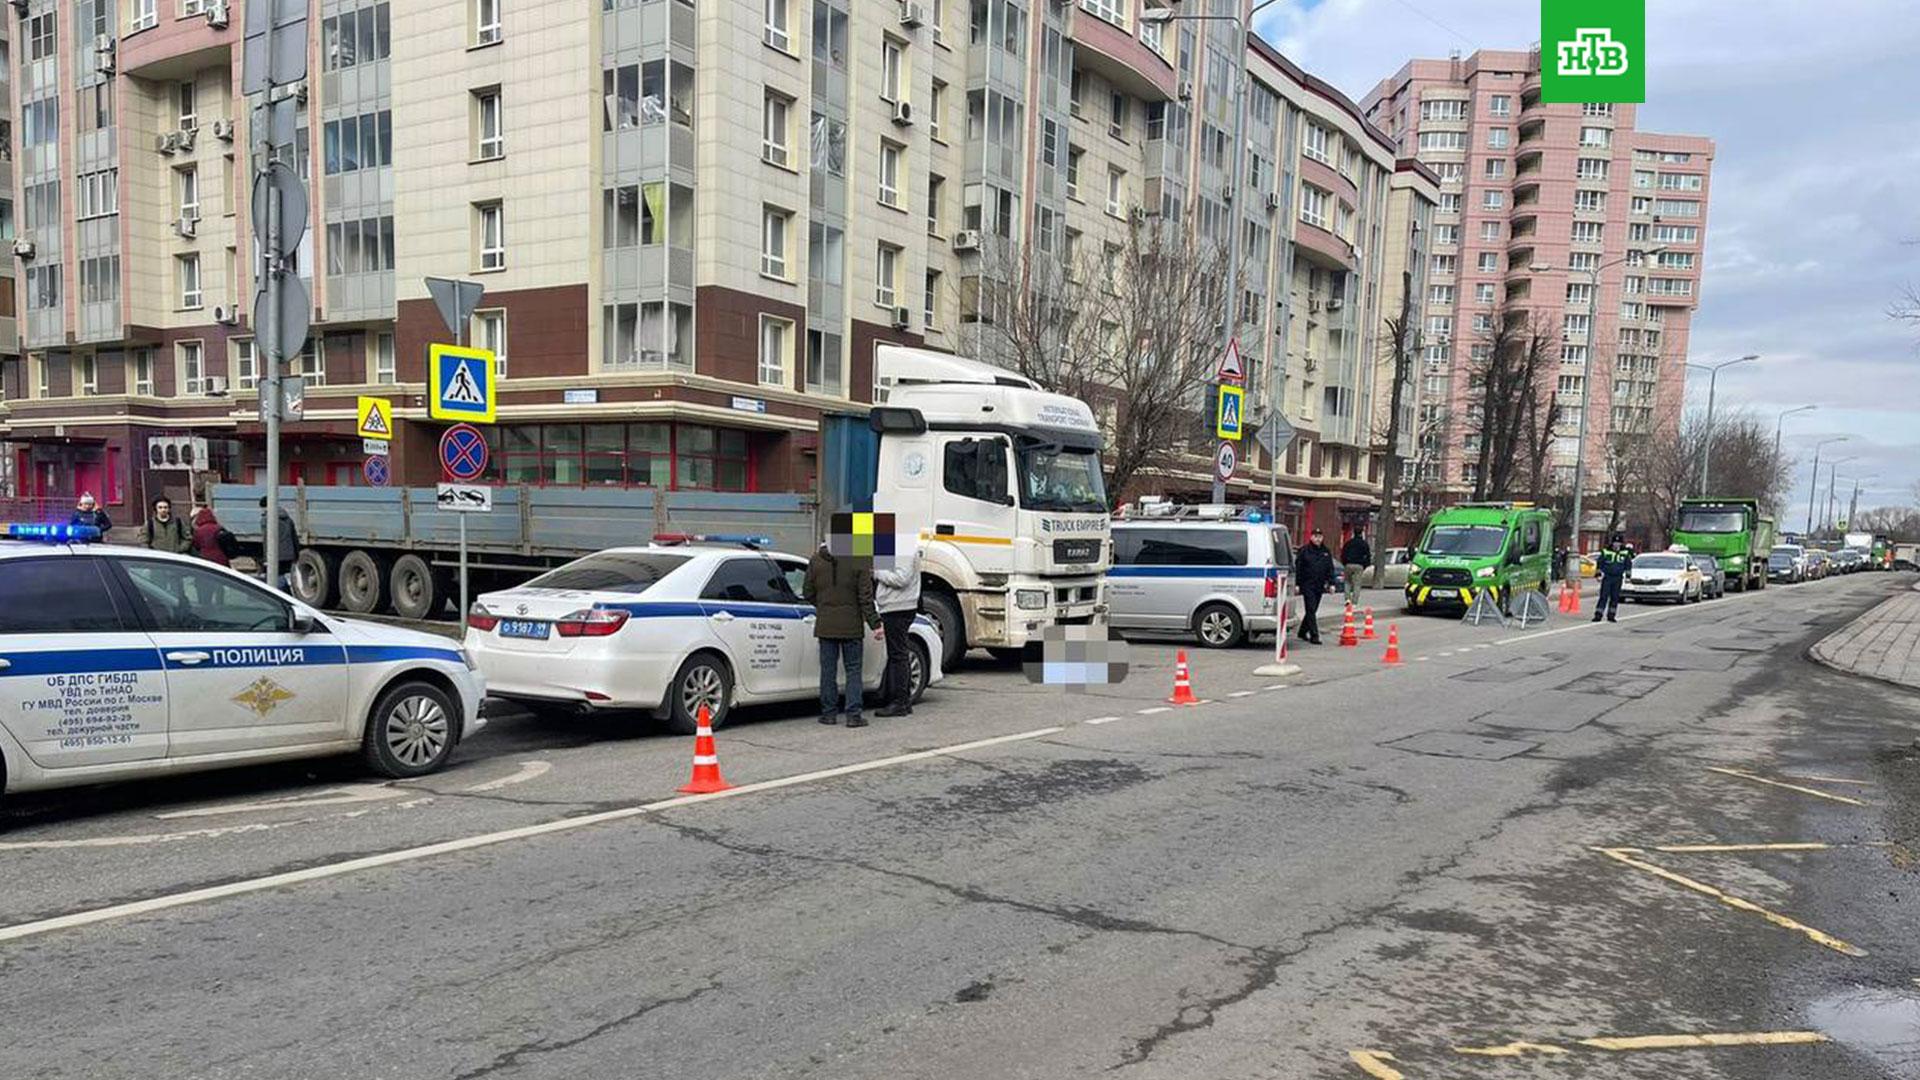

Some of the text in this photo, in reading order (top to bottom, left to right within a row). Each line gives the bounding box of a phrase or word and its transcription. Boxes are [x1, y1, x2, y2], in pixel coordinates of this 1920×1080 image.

[1221, 453, 1233, 469] 40
[1051, 519, 1101, 532] TRUCK EMPIRE
[213, 648, 304, 664] ПОЛИЦИЯ
[47, 672, 138, 687] ОБ ДПС ГИБДД
[59, 685, 133, 698] УВД по ТиНАО
[22, 700, 36, 711] ГУ
[38, 699, 63, 710] МВД
[65, 697, 102, 708] России
[104, 697, 117, 706] по
[128, 694, 163, 704] Москве
[63, 705, 130, 716] тел. доверия
[46, 722, 140, 737] тел. дежурной части
